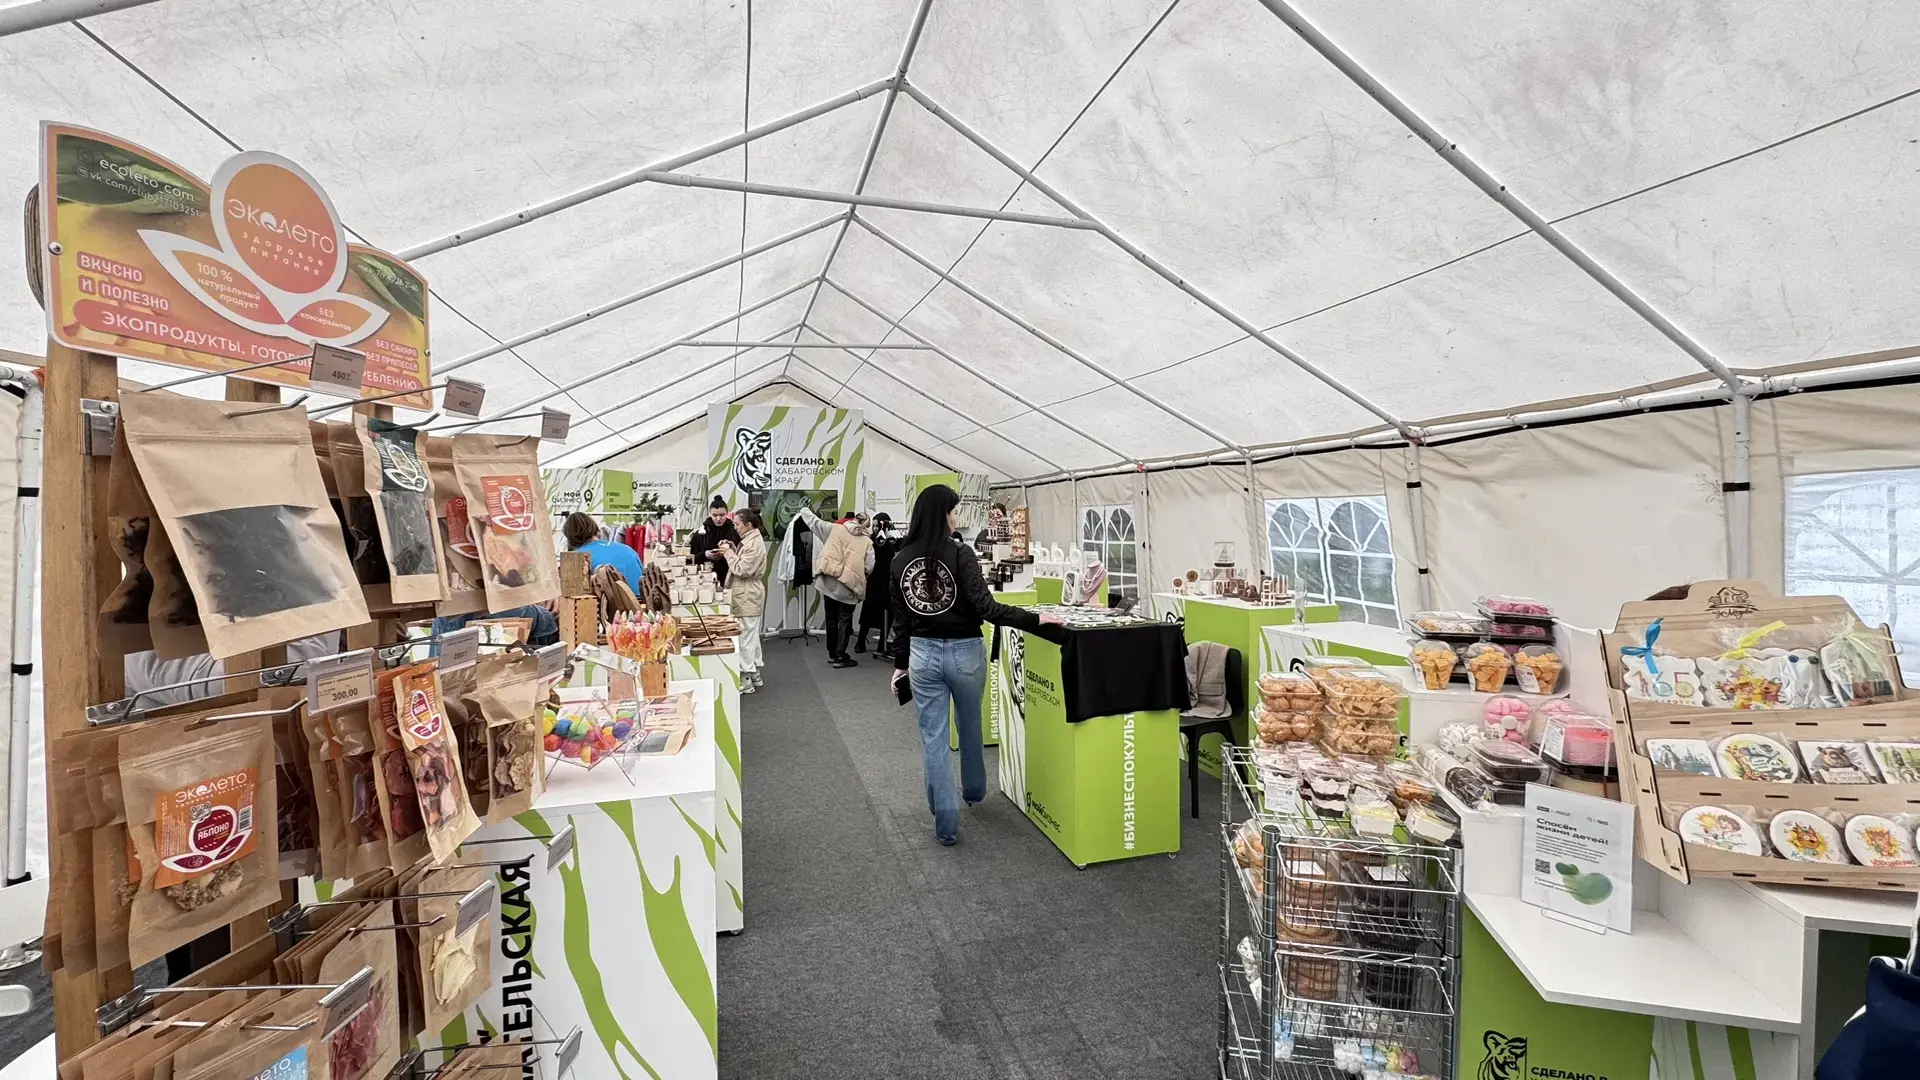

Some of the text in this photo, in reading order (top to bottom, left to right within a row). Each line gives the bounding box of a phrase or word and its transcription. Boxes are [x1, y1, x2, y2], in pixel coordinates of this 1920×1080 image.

[100, 159, 194, 202] ecoleto_com
[80, 254, 143, 282] ВКУСНО
[197, 262, 233, 283] 100 %
[82, 278, 169, 311] И ПОЛЕЗНО
[198, 277, 261, 301] натуральный
[219, 294, 260, 309] продукт
[300, 312, 353, 332] консервантов
[318, 307, 335, 318] БЕЗ
[366, 351, 382, 362] БЕЗ
[375, 339, 417, 356] БЕЗ САХАРА
[363, 370, 417, 390] ЕБЛЕНИЮ
[774, 467, 845, 476] ХАБАРОВСКОМ
[775, 457, 825, 466] СДЕЛАНО
[774, 476, 799, 485] КРАЕ
[1025, 669, 1055, 692] СДЕЛАНО В
[990, 659, 999, 739] #БИЗНЕСПОКУ
[1025, 682, 1061, 708] ХАБАРОВСКОМ
[197, 821, 230, 841] ЯБЛОКО
[1536, 817, 1578, 832] Спасём
[1536, 824, 1609, 846] жизни детей!
